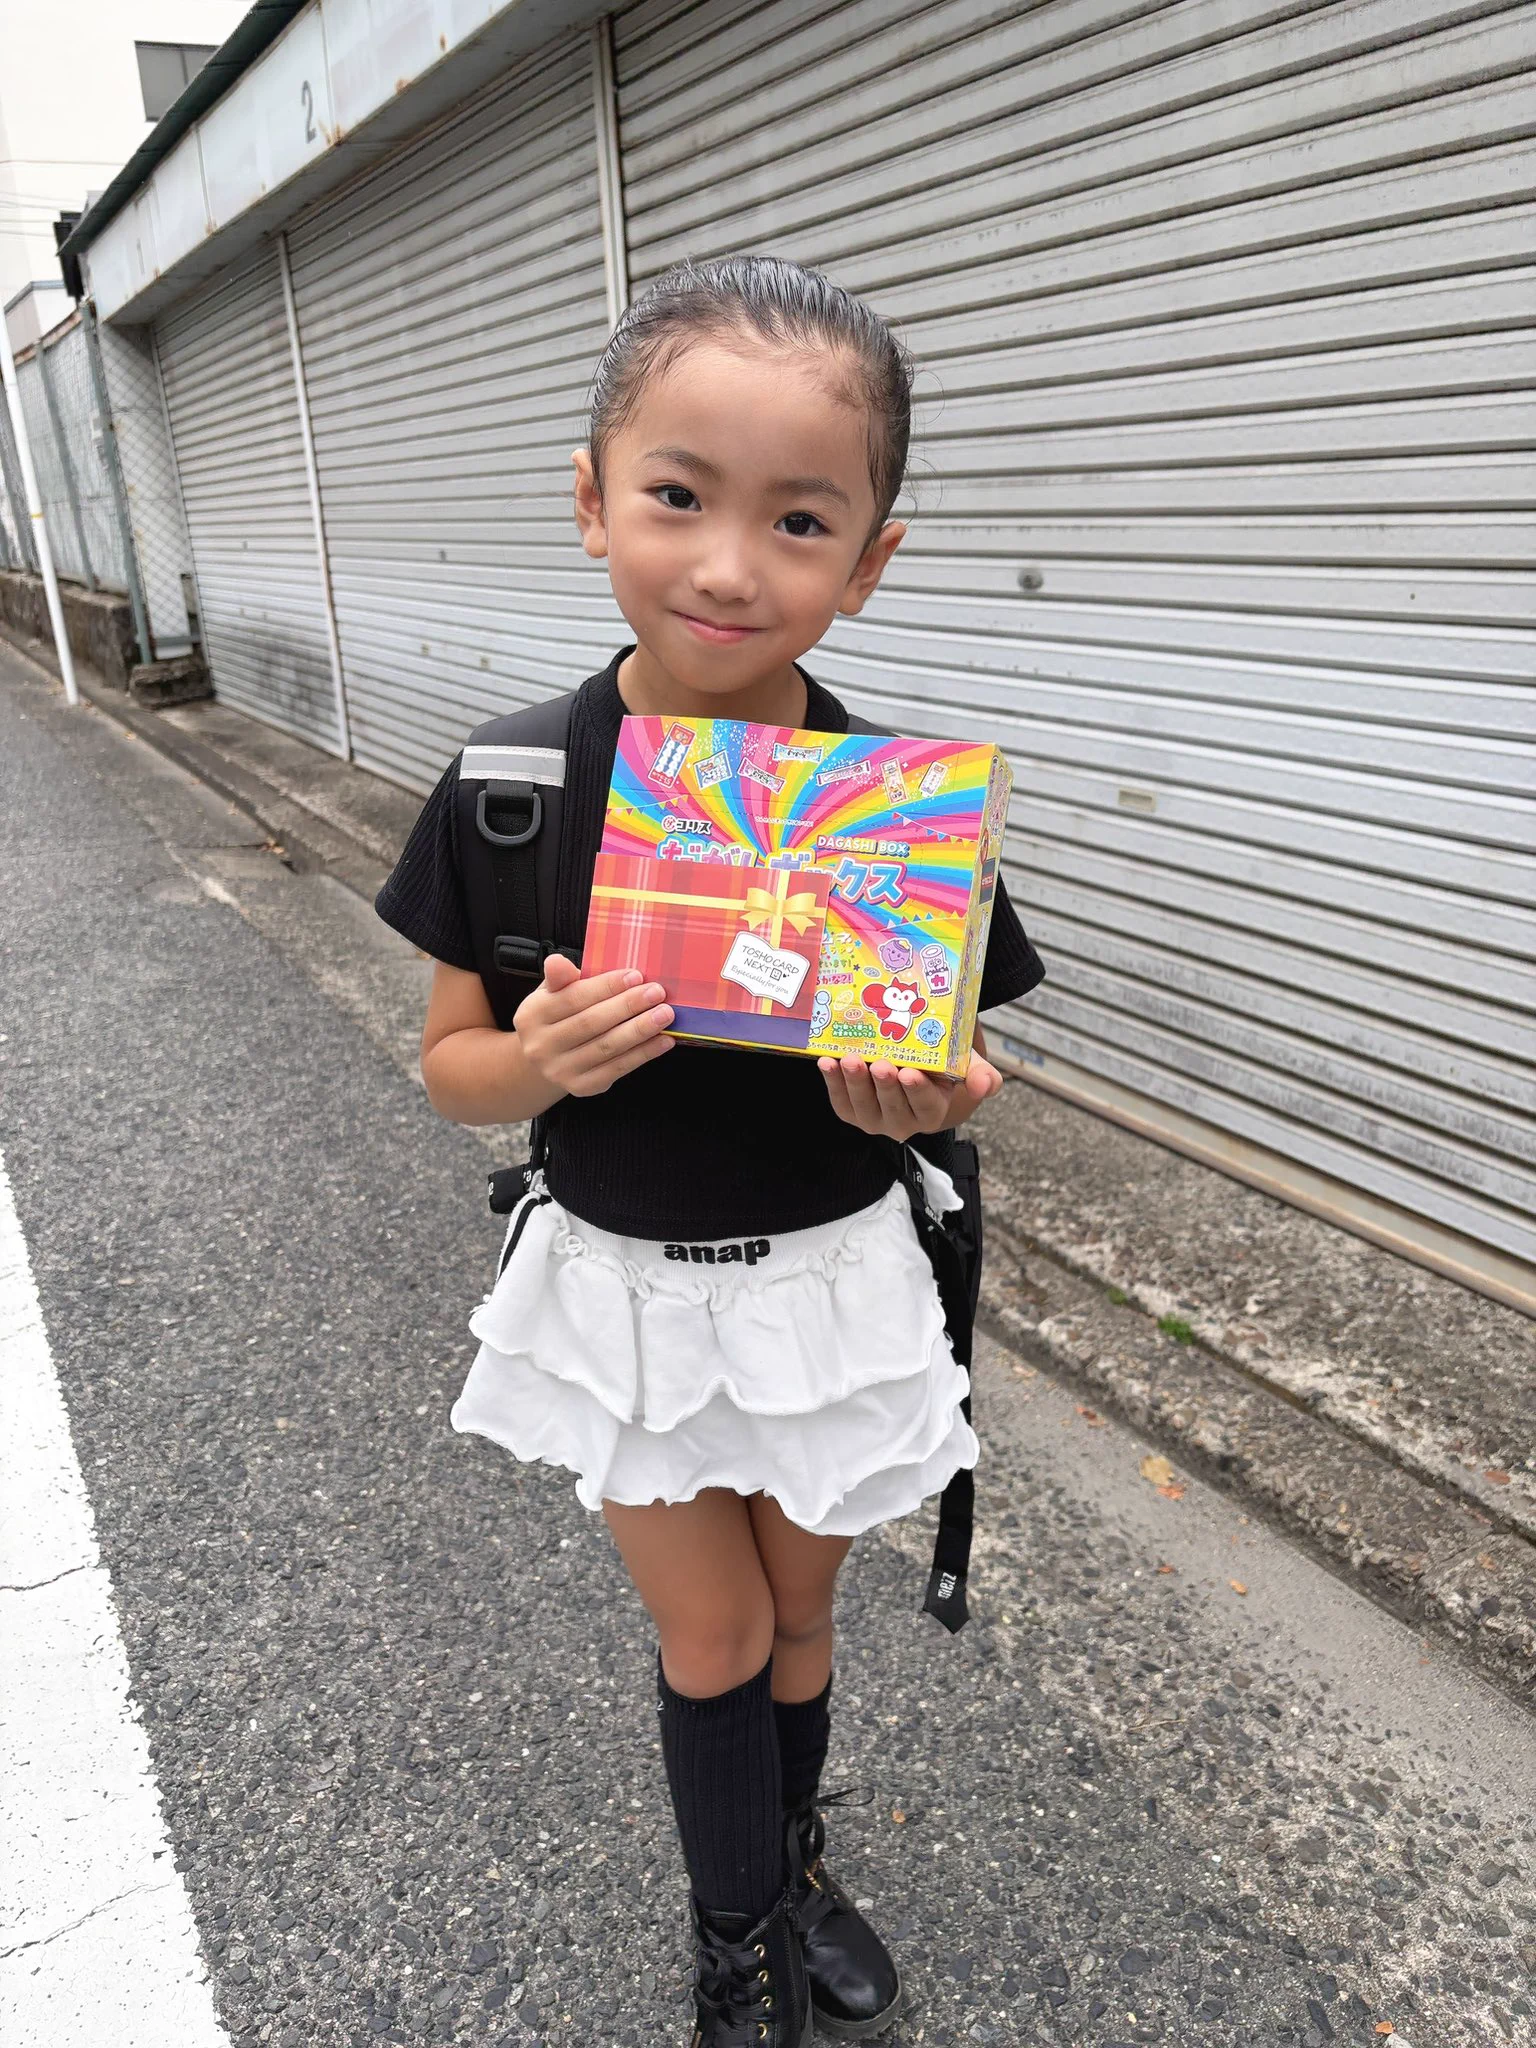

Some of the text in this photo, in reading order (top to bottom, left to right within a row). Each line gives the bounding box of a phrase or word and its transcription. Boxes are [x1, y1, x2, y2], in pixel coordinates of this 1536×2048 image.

[302, 80, 316, 144] 2
[676, 819, 710, 833] コリス
[818, 836, 907, 854] DAGASHI BOX
[742, 945, 799, 974] TOSHO CARD
[744, 958, 771, 974] NEXT
[775, 984, 789, 995] you
[664, 1239, 770, 1266] anap
